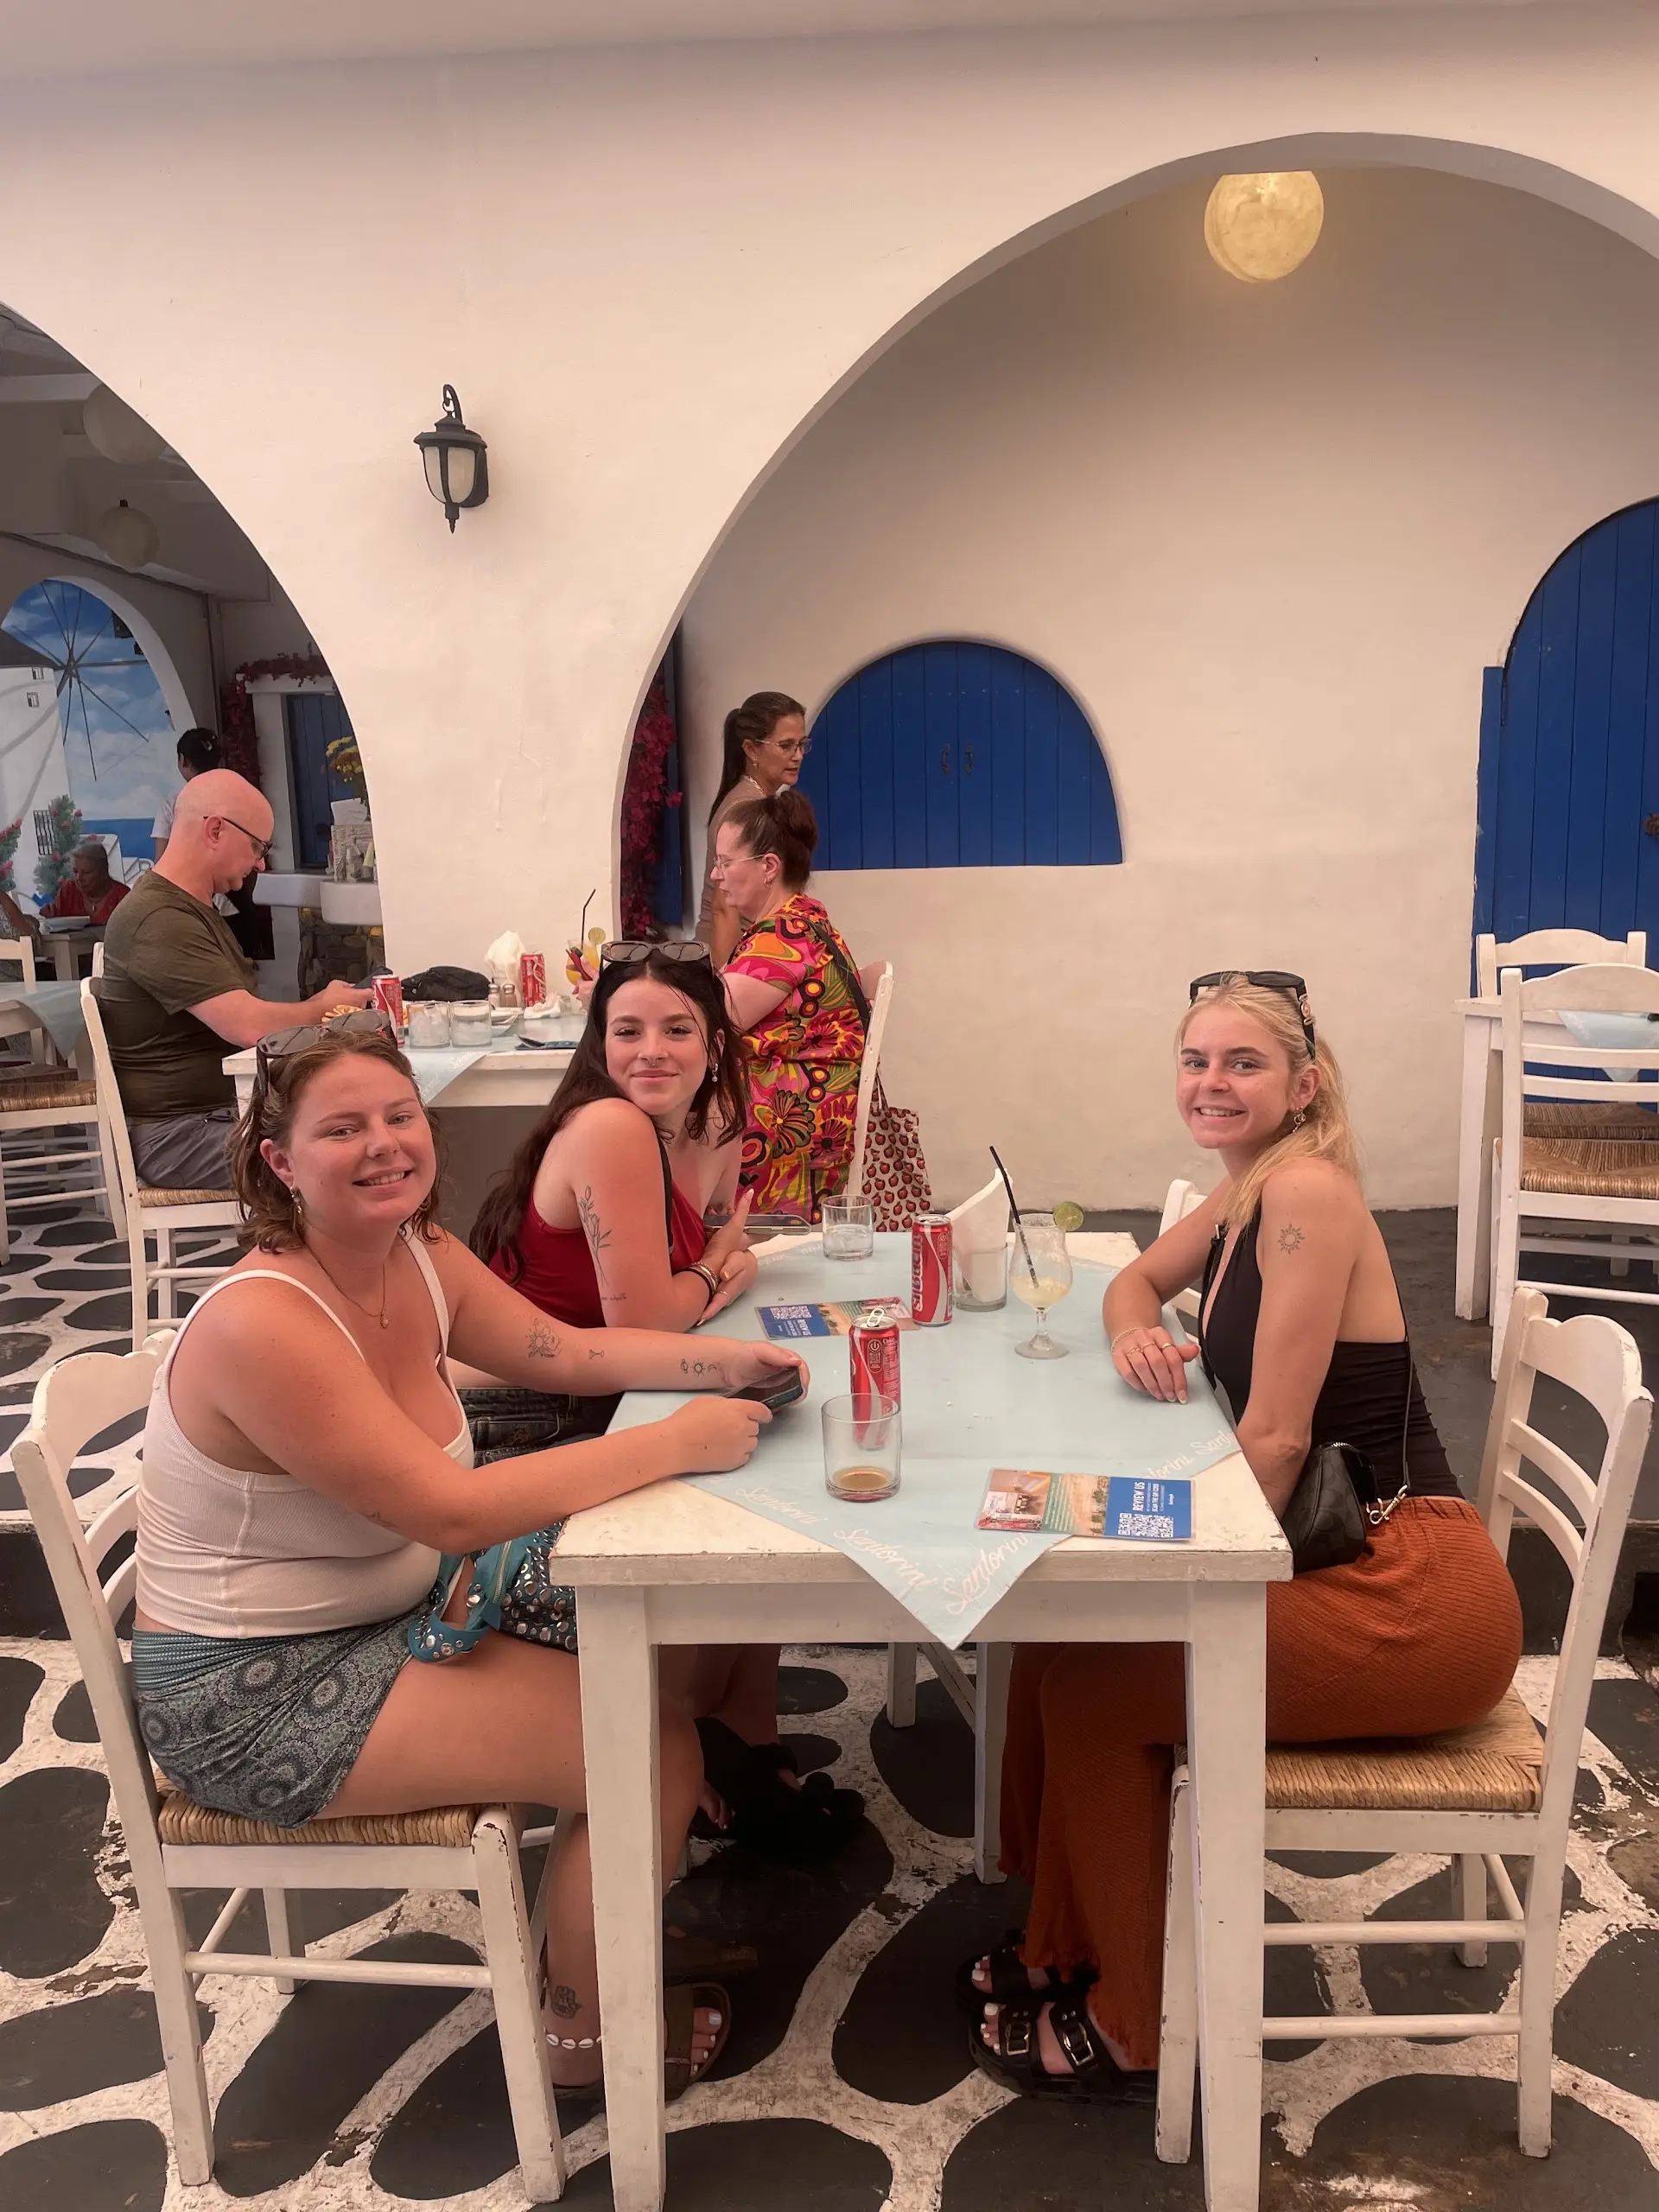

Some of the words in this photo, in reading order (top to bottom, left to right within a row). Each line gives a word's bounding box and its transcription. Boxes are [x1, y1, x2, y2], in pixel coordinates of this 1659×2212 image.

[1133, 1490, 1144, 1511] REVIEW
[1134, 1481, 1145, 1490] US
[834, 1528, 939, 1592] Santorini
[943, 1532, 1033, 1615] Santorini
